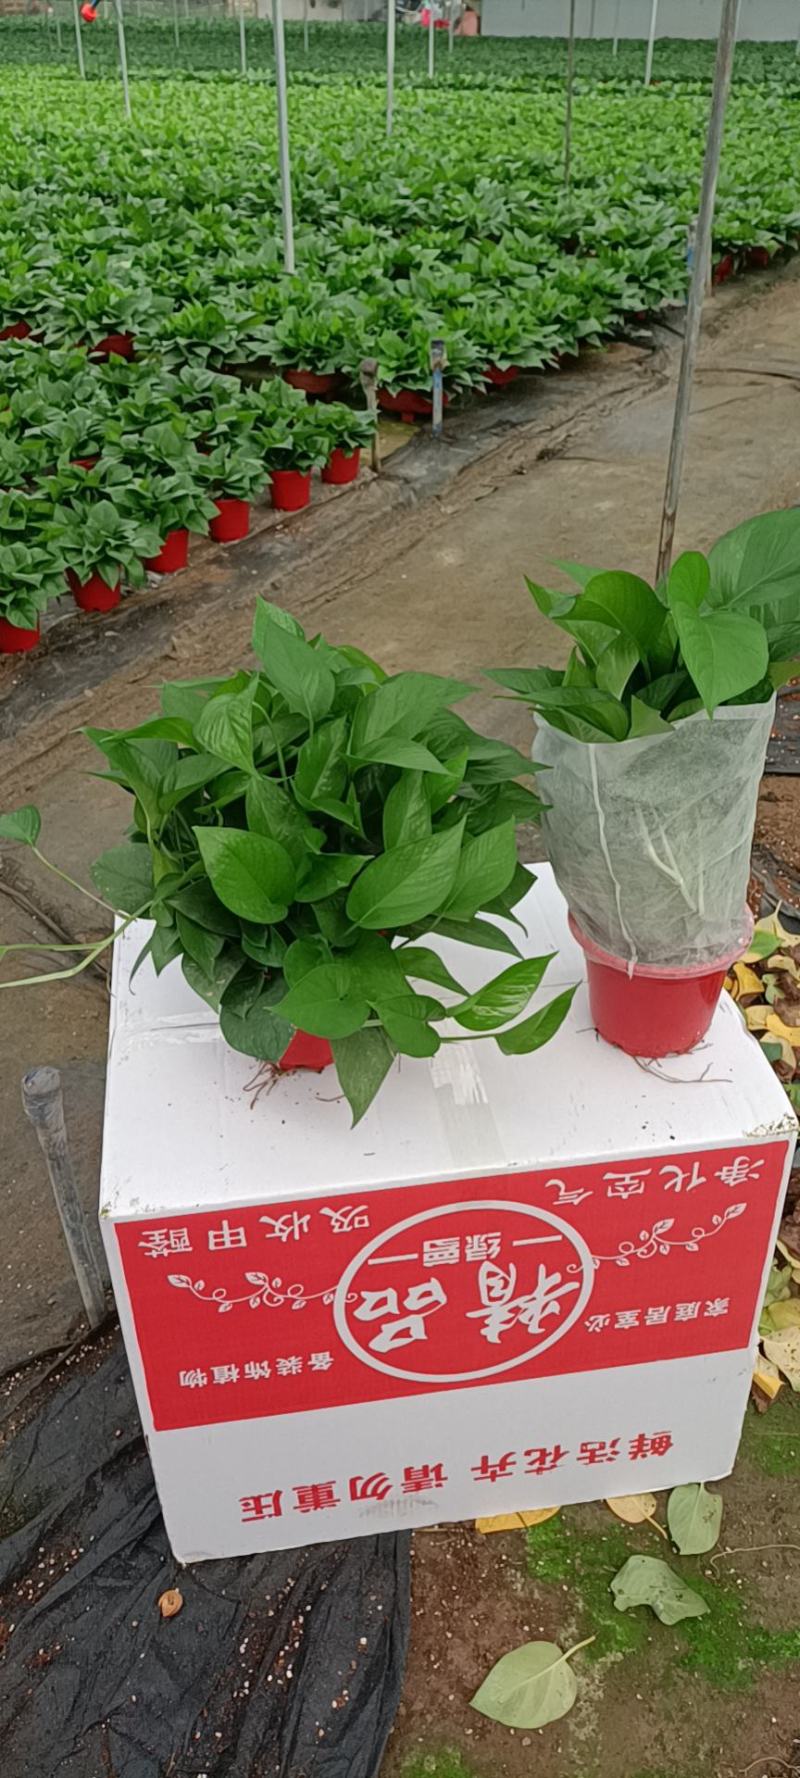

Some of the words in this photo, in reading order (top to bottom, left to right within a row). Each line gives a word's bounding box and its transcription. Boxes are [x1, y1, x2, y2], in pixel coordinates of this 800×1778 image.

[545, 1156, 764, 1205] 净化空气
[138, 1205, 370, 1258] 吸收甲醛
[423, 1232, 501, 1267] 绿萝
[353, 1260, 580, 1353] 精品
[584, 1297, 730, 1332] 家庭居室必
[179, 1351, 334, 1388] 备装饰植物
[470, 1430, 674, 1482] 鲜活花卉
[239, 1462, 448, 1523] 请勿重压
